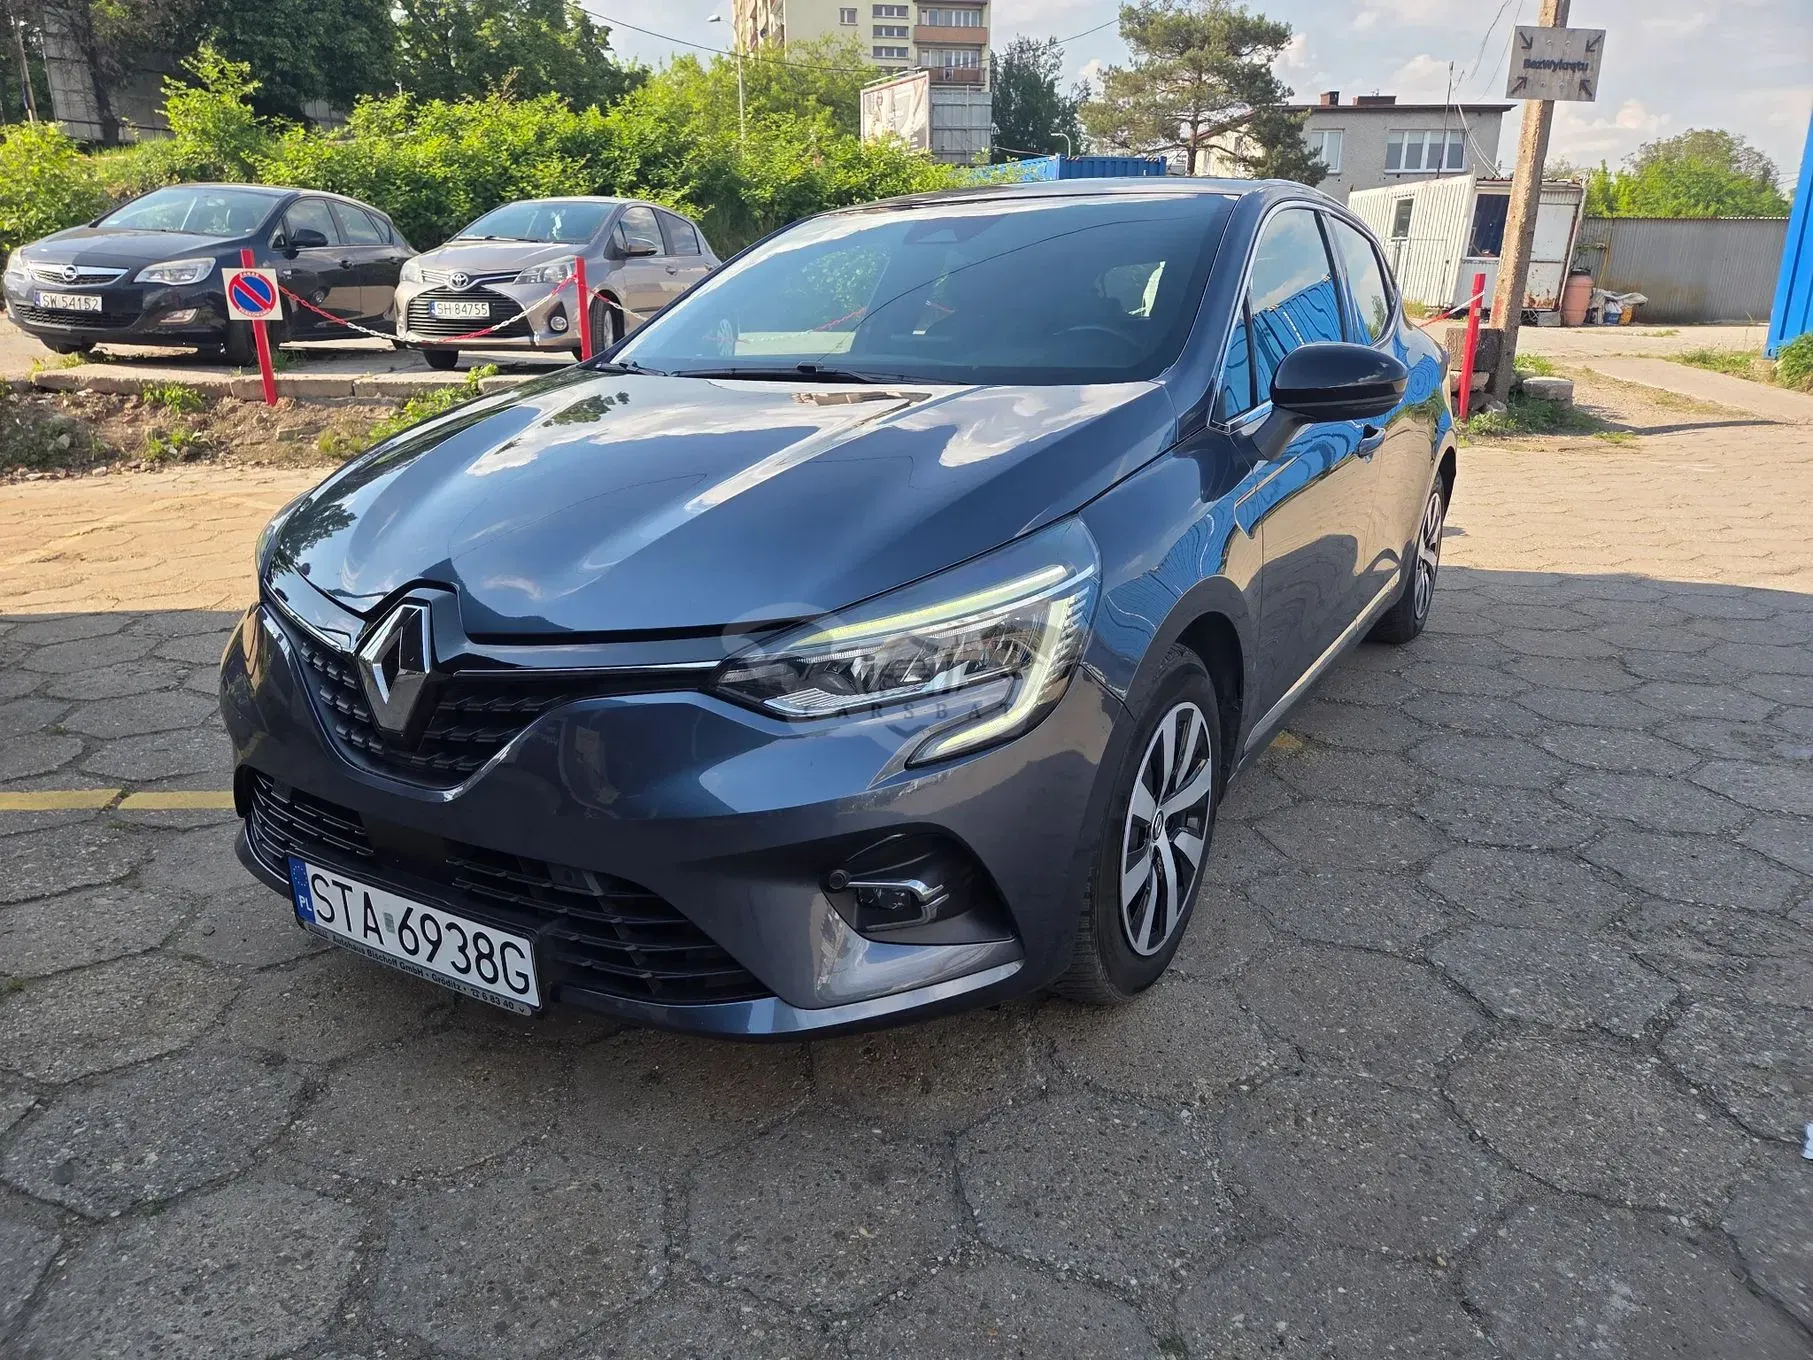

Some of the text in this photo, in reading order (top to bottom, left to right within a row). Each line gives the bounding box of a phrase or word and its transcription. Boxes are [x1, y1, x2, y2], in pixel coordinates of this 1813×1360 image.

[42, 294, 99, 312] SW 54152
[438, 303, 488, 315] SH 84755
[298, 894, 313, 912] PL
[310, 873, 530, 995] STA 6938G
[332, 934, 365, 955] Autohaus
[366, 948, 398, 968] Bischoff
[400, 961, 424, 977] GmbH
[431, 972, 461, 992] Gröditz
